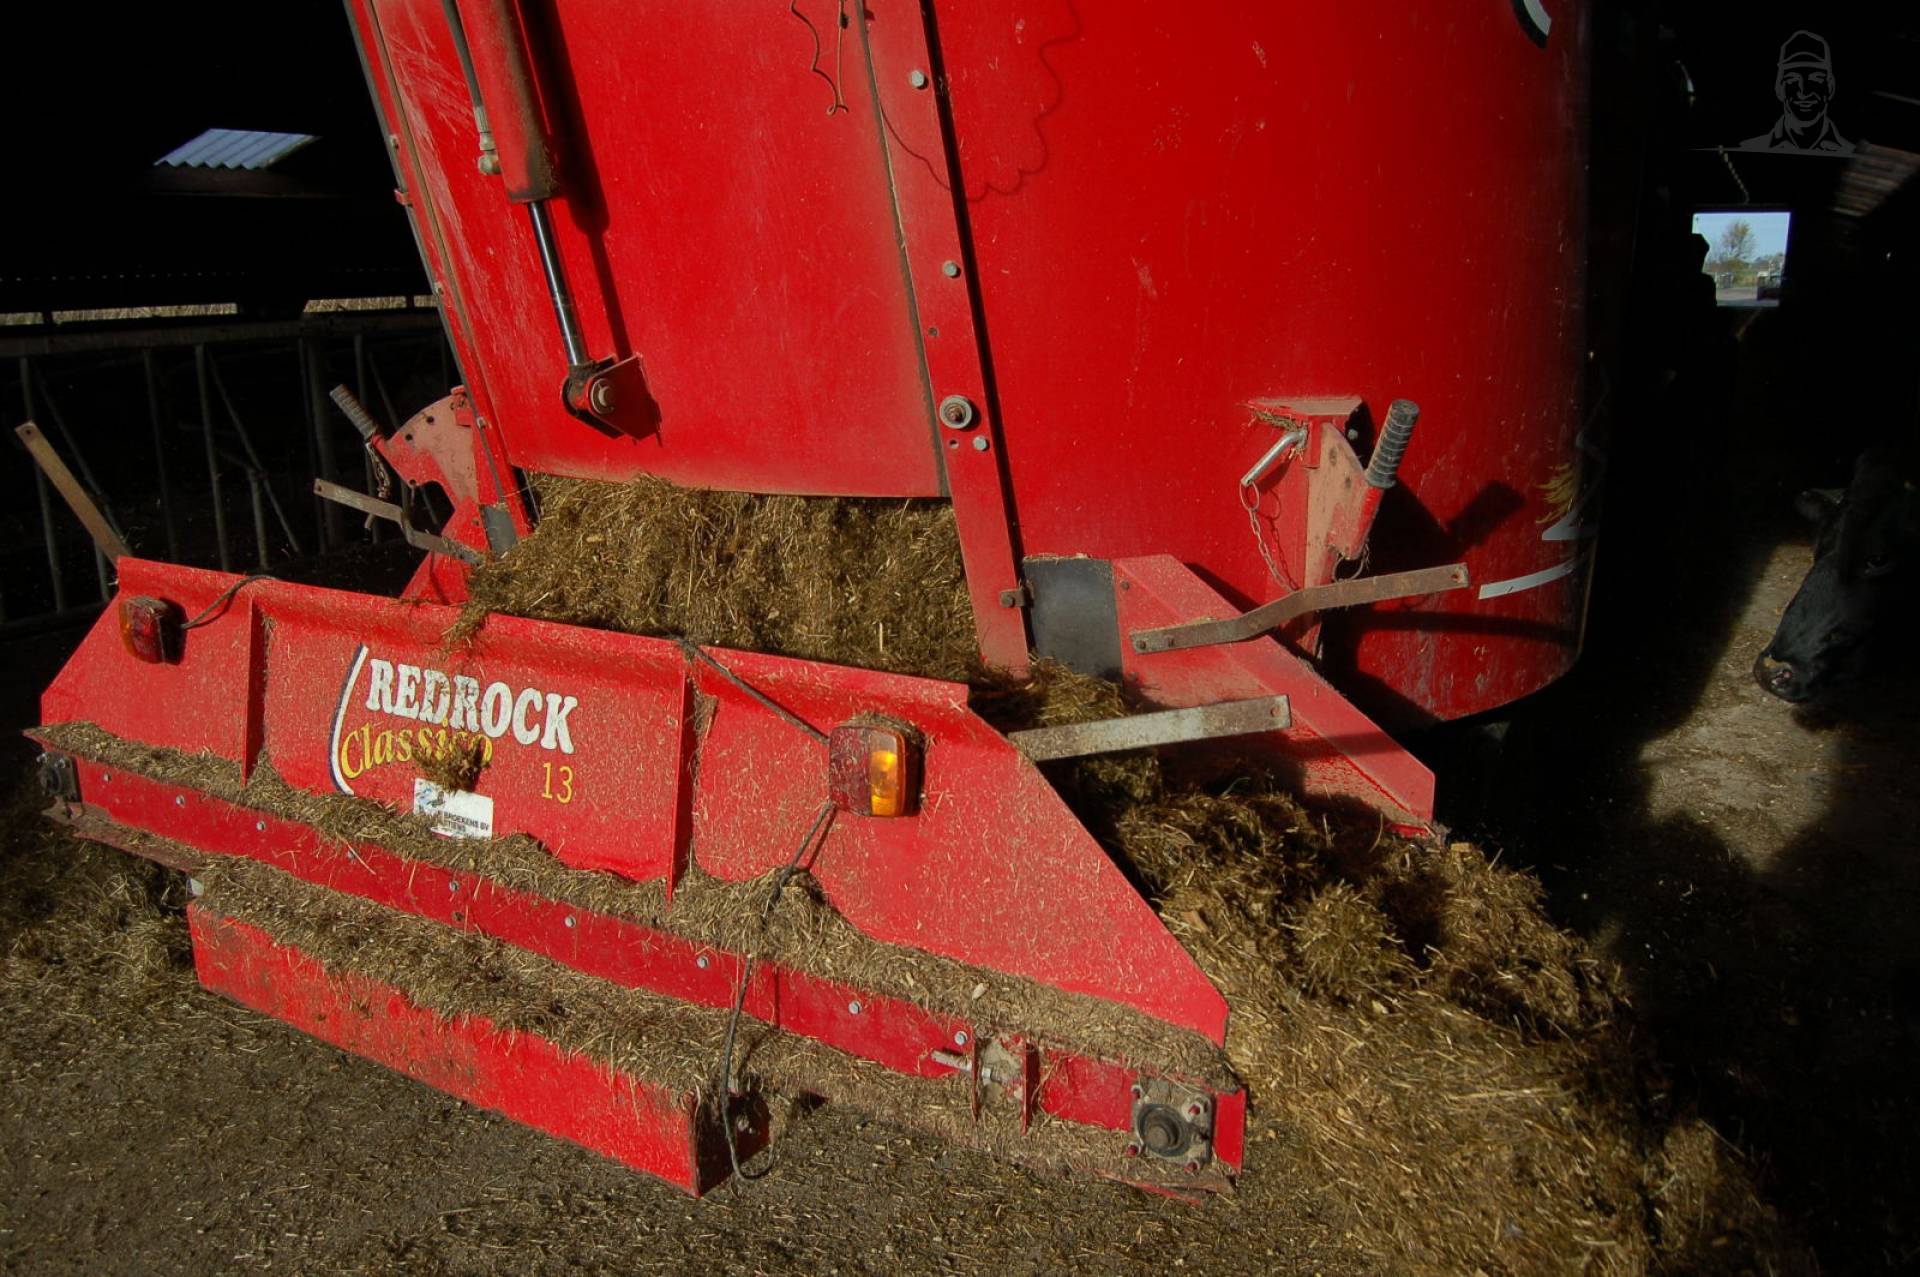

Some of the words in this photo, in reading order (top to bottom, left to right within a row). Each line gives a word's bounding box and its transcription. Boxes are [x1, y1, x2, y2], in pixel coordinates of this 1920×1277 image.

[366, 659, 577, 754] REDROCK
[341, 717, 492, 778] Classico
[542, 762, 575, 804] 13
